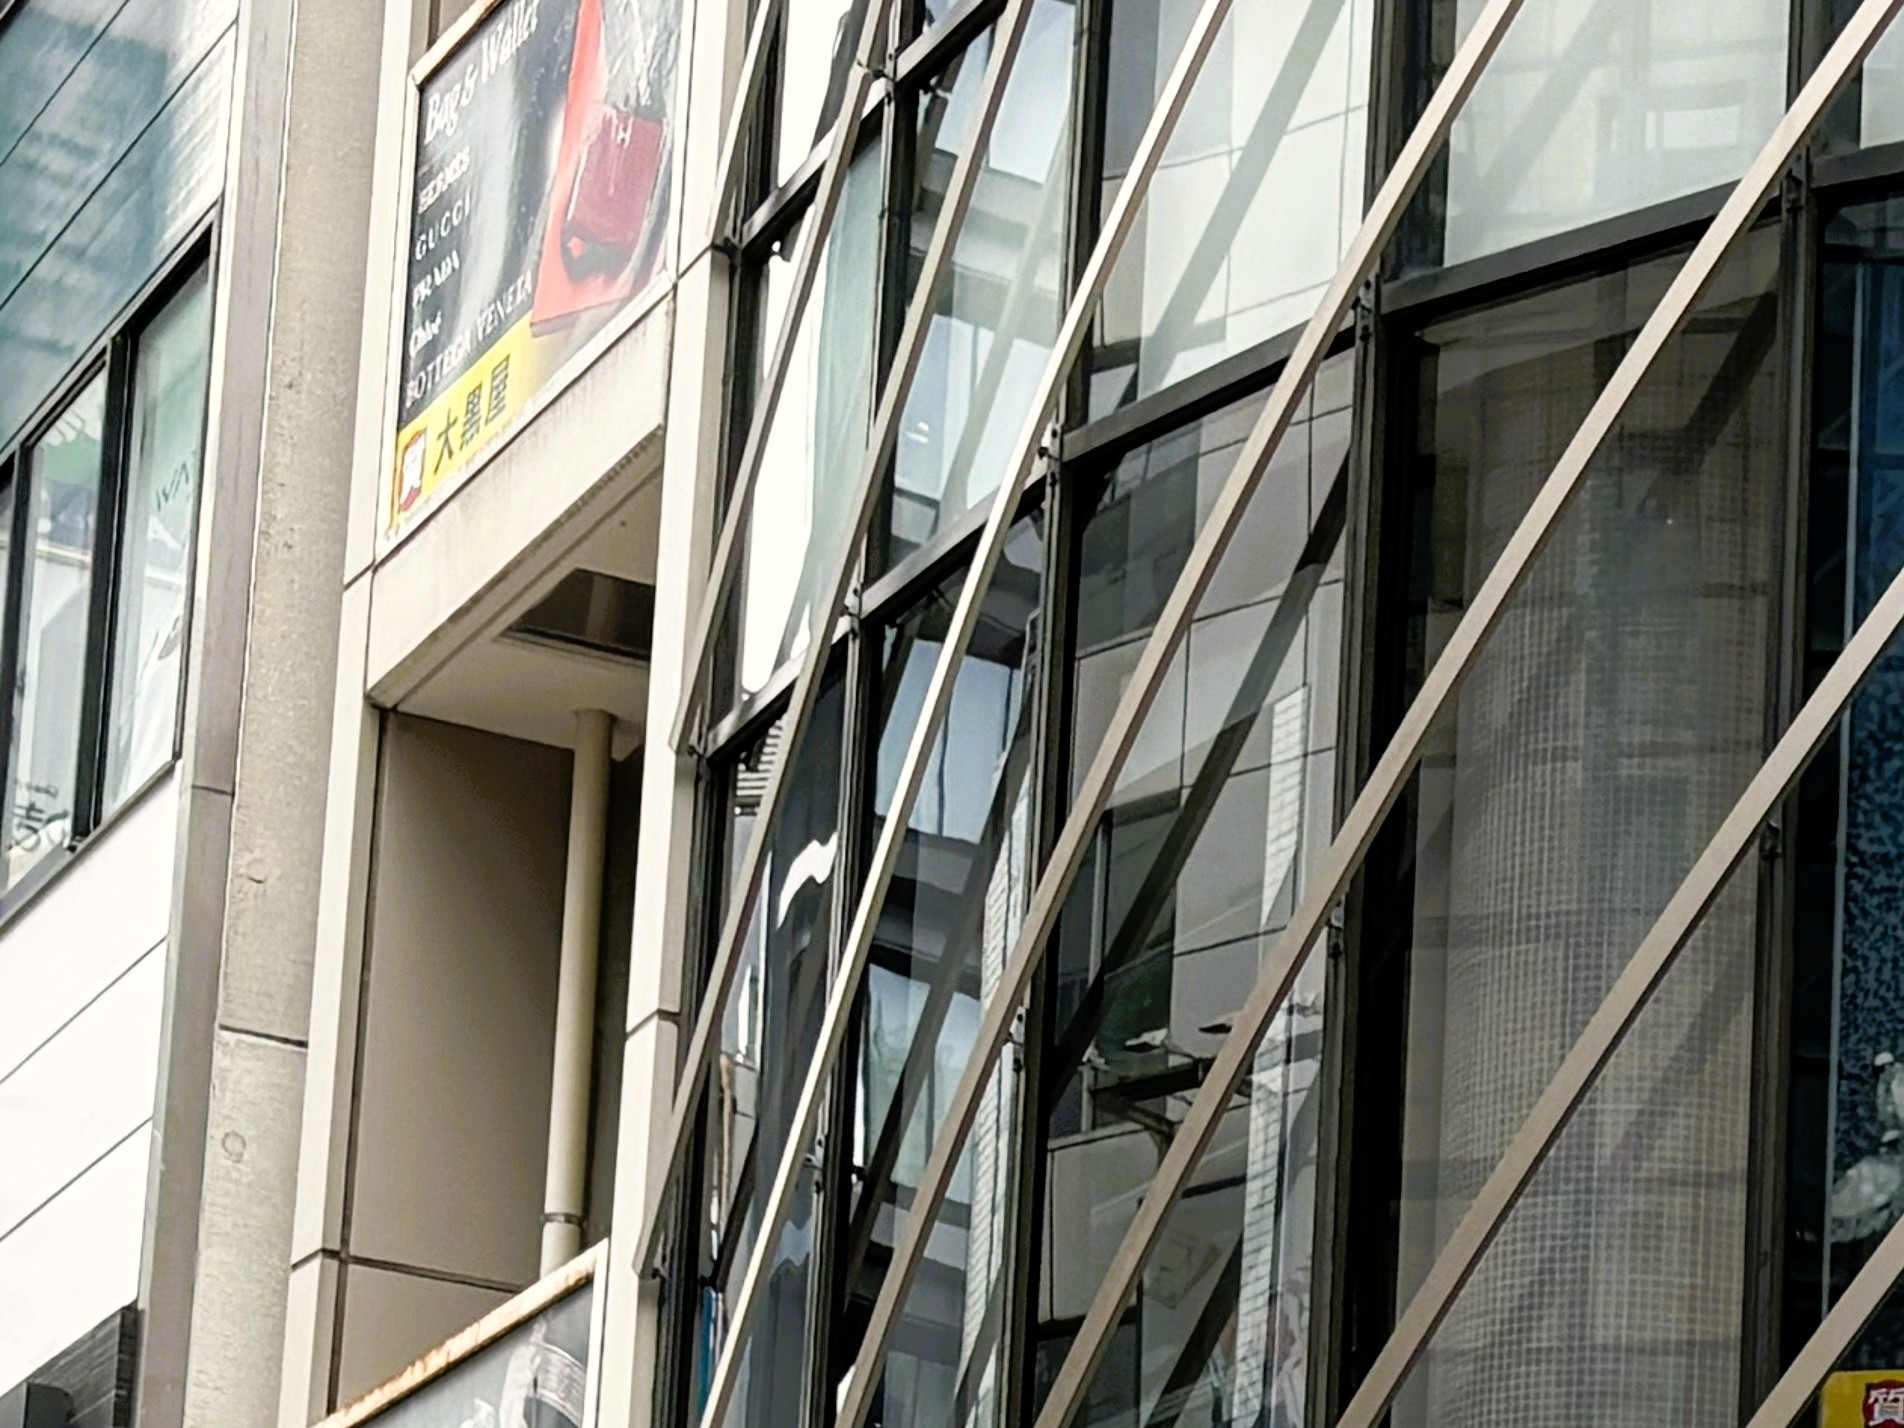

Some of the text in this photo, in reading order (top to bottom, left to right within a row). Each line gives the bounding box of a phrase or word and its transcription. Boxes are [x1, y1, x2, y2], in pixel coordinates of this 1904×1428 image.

[415, 192, 470, 260] GUCCI
[433, 352, 512, 476] 大黒屋
